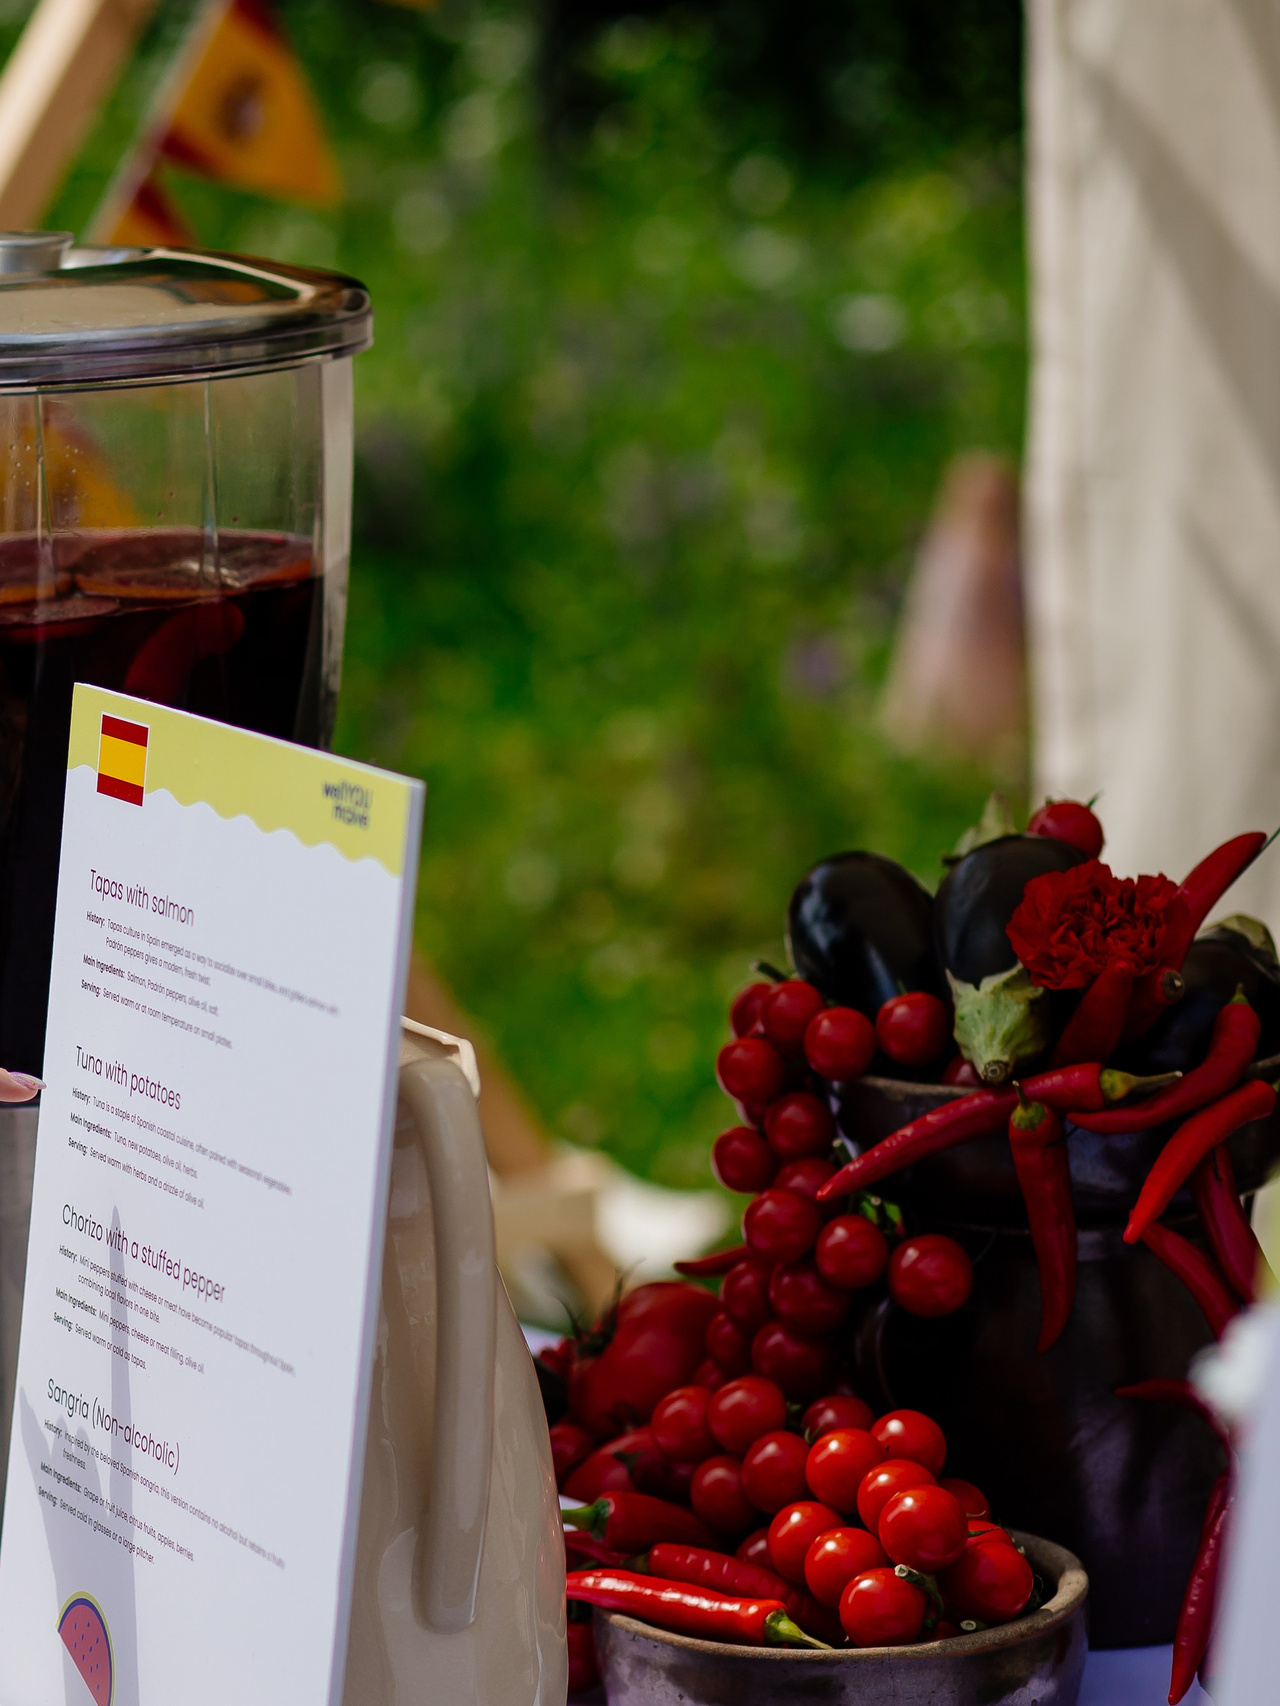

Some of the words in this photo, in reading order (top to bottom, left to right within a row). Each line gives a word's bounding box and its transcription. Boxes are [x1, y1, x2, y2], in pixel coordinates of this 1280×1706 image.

[333, 804, 368, 829] move
[90, 869, 124, 901] Tapas
[126, 884, 149, 910] with
[151, 895, 194, 925] salmon
[86, 911, 105, 928] History:
[107, 918, 123, 933] Tapas
[123, 926, 140, 940] culture
[141, 930, 146, 942] in
[146, 933, 160, 947] Spain
[161, 940, 184, 957] emerged
[184, 949, 191, 959] as
[196, 954, 207, 965] way
[106, 936, 123, 952] Padrón
[124, 945, 144, 960] peppers
[144, 952, 158, 966] gives
[163, 960, 184, 976] modern,
[184, 966, 197, 980] fresh
[81, 979, 101, 998] Serving:
[103, 987, 120, 1003] Served
[120, 996, 135, 1009] warm
[134, 1002, 141, 1011] or
[141, 1005, 147, 1014] at
[147, 1007, 161, 1017] room
[161, 1012, 193, 1032] temperature
[193, 1026, 200, 1035] on
[200, 1029, 215, 1041] small
[83, 954, 95, 967] Main
[96, 959, 125, 978] Ingredients:
[127, 971, 146, 989] Salmon,
[147, 979, 165, 994] Padrón
[165, 988, 187, 1004] peppers,
[188, 996, 201, 1009] olive
[76, 1045, 103, 1076] Tuna
[105, 1060, 128, 1087] with
[130, 1073, 181, 1110] potatoes
[70, 1112, 82, 1126] Main
[83, 1118, 112, 1139] Ingredients:
[114, 1131, 127, 1147] Tuna,
[128, 1139, 138, 1151] new
[138, 1145, 162, 1163] potatoes,
[162, 1155, 175, 1168] olive
[183, 1163, 198, 1179] herbs.
[72, 1087, 91, 1105] History:
[93, 1096, 105, 1110] Tuna
[105, 1101, 110, 1112] is
[115, 1107, 130, 1122] staple
[130, 1114, 136, 1124] of
[136, 1115, 156, 1132] Spanish
[156, 1126, 176, 1141] coastal
[176, 1135, 194, 1151] cuisine,
[195, 1143, 209, 1156] often
[68, 1137, 88, 1156] Serving:
[90, 1146, 107, 1163] Served
[107, 1156, 121, 1169] warm
[122, 1163, 132, 1175] with
[133, 1166, 147, 1182] herbs
[147, 1175, 158, 1187] and
[163, 1182, 178, 1197] drizzle
[179, 1189, 185, 1199] of
[185, 1192, 197, 1205] olive
[62, 1204, 103, 1241] Chorizo
[106, 1227, 128, 1255] with
[131, 1241, 139, 1260] a
[141, 1245, 181, 1280] stuffed
[182, 1267, 225, 1302] pepper
[59, 1245, 78, 1263] History:
[79, 1255, 90, 1268] Mini
[90, 1261, 110, 1278] peppers
[110, 1272, 128, 1287] stuffed
[128, 1280, 139, 1293] with
[139, 1286, 157, 1303] cheese
[157, 1296, 164, 1305] or
[164, 1299, 178, 1313] meat
[178, 1305, 191, 1320] have
[191, 1312, 213, 1332] become
[78, 1274, 104, 1297] combining
[104, 1285, 117, 1300] local
[117, 1292, 133, 1310] flavors
[133, 1300, 139, 1312] in
[139, 1306, 149, 1318] one
[149, 1309, 160, 1323] bite.
[53, 1312, 73, 1332] Serving:
[75, 1323, 92, 1340] Served
[92, 1334, 107, 1348] warm
[107, 1342, 113, 1351] or
[112, 1345, 124, 1357] cold
[124, 1351, 131, 1361] as
[131, 1354, 146, 1370] tapas.
[56, 1287, 68, 1301] Main
[68, 1294, 97, 1317] Ingredients:
[99, 1309, 109, 1323] Mini
[109, 1317, 130, 1336] peppers,
[131, 1328, 149, 1344] cheese
[149, 1338, 156, 1347] or
[156, 1341, 170, 1355] meat
[170, 1346, 184, 1366] filling,
[185, 1356, 197, 1370] olive
[47, 1378, 89, 1419] Sangria
[92, 1397, 180, 1475] (Non-alcoholic)
[63, 1448, 86, 1470] freshness.
[40, 1461, 52, 1476] Main
[53, 1469, 82, 1493] Ingredients:
[83, 1487, 99, 1504] Grape
[99, 1498, 105, 1507] or
[105, 1499, 116, 1514] fruit
[114, 1505, 128, 1523] juice,
[129, 1515, 143, 1530] citrus
[143, 1522, 156, 1540] fruits,
[157, 1532, 175, 1551] apples,
[176, 1542, 194, 1561] berries.
[44, 1419, 63, 1439] History:
[65, 1430, 84, 1450] Inspired
[84, 1441, 91, 1456] by
[91, 1447, 99, 1459] the
[99, 1450, 120, 1470] beloved
[120, 1462, 140, 1482] Spanish
[140, 1476, 160, 1495] sangria,
[160, 1487, 170, 1500] this
[170, 1494, 189, 1511] version
[189, 1505, 211, 1525] contains
[211, 1518, 219, 1529] no
[218, 1523, 238, 1540] alcohol
[38, 1486, 58, 1507] Serving:
[60, 1498, 77, 1516] Served
[76, 1510, 88, 1523] cold
[88, 1514, 93, 1527] in
[93, 1520, 112, 1538] glasses
[112, 1532, 118, 1541] or
[123, 1536, 136, 1554] large
[136, 1546, 154, 1563] pitcher.
